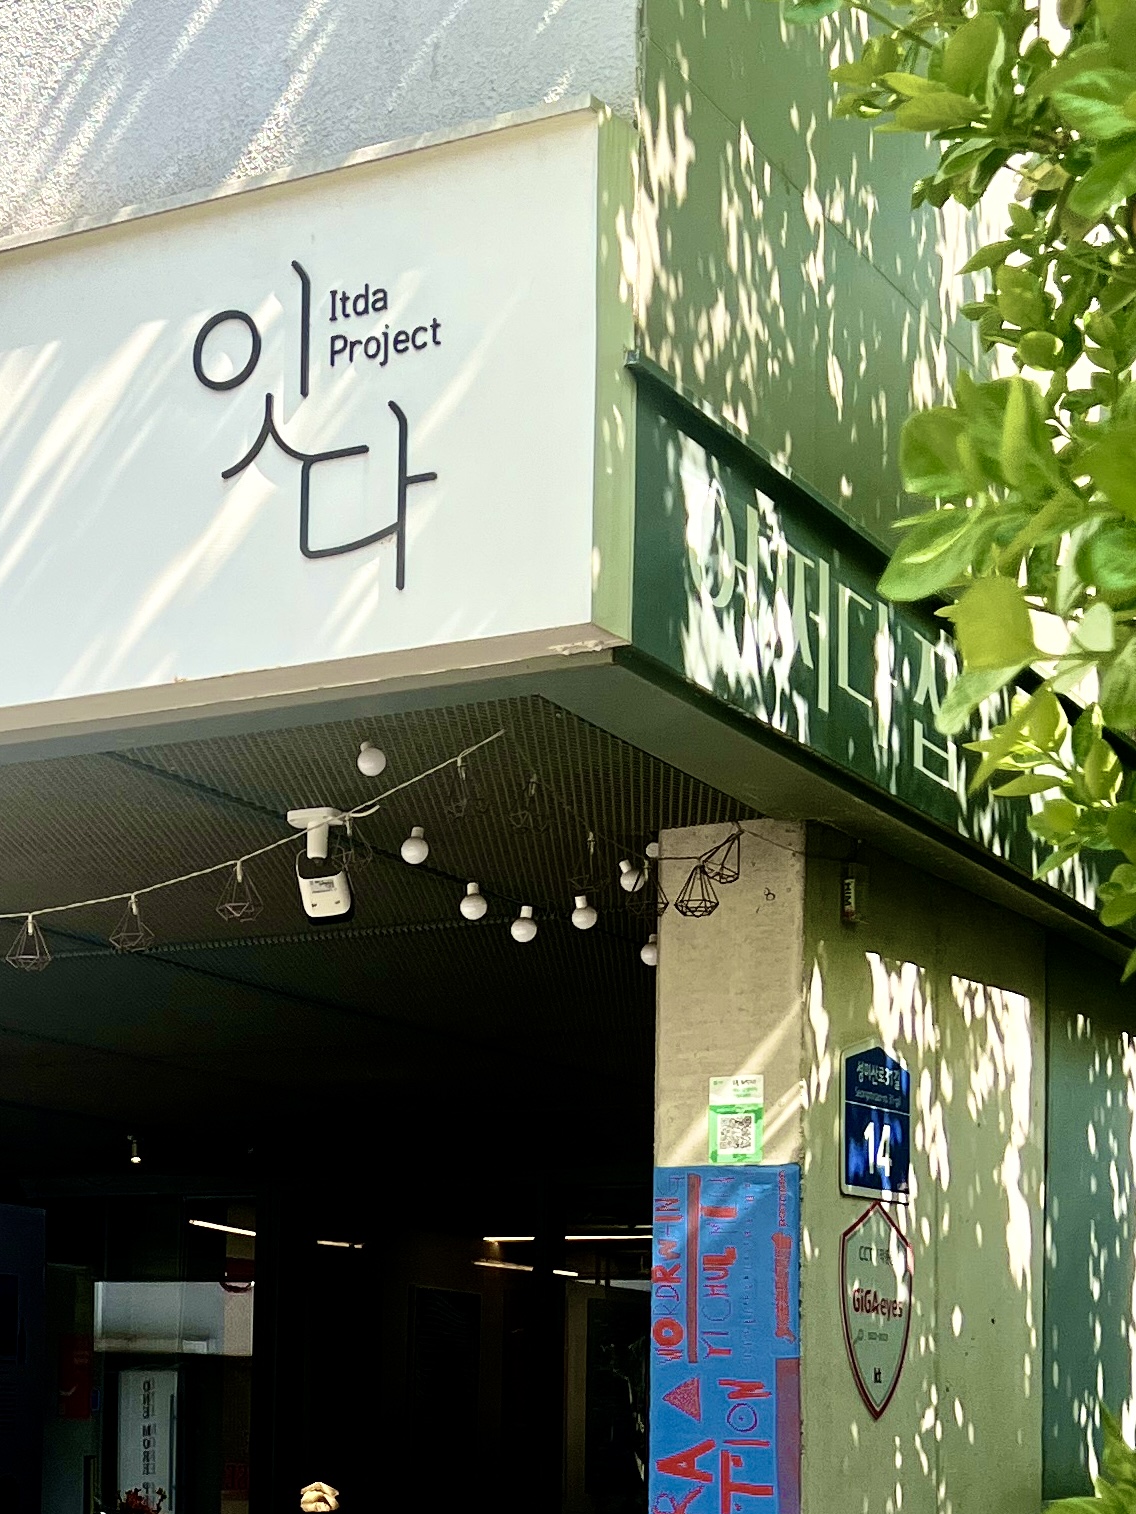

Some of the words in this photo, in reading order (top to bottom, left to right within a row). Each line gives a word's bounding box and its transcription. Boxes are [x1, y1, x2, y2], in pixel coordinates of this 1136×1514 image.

[328, 283, 389, 322] Itda
[328, 317, 442, 367] Project
[863, 1120, 892, 1178] 14
